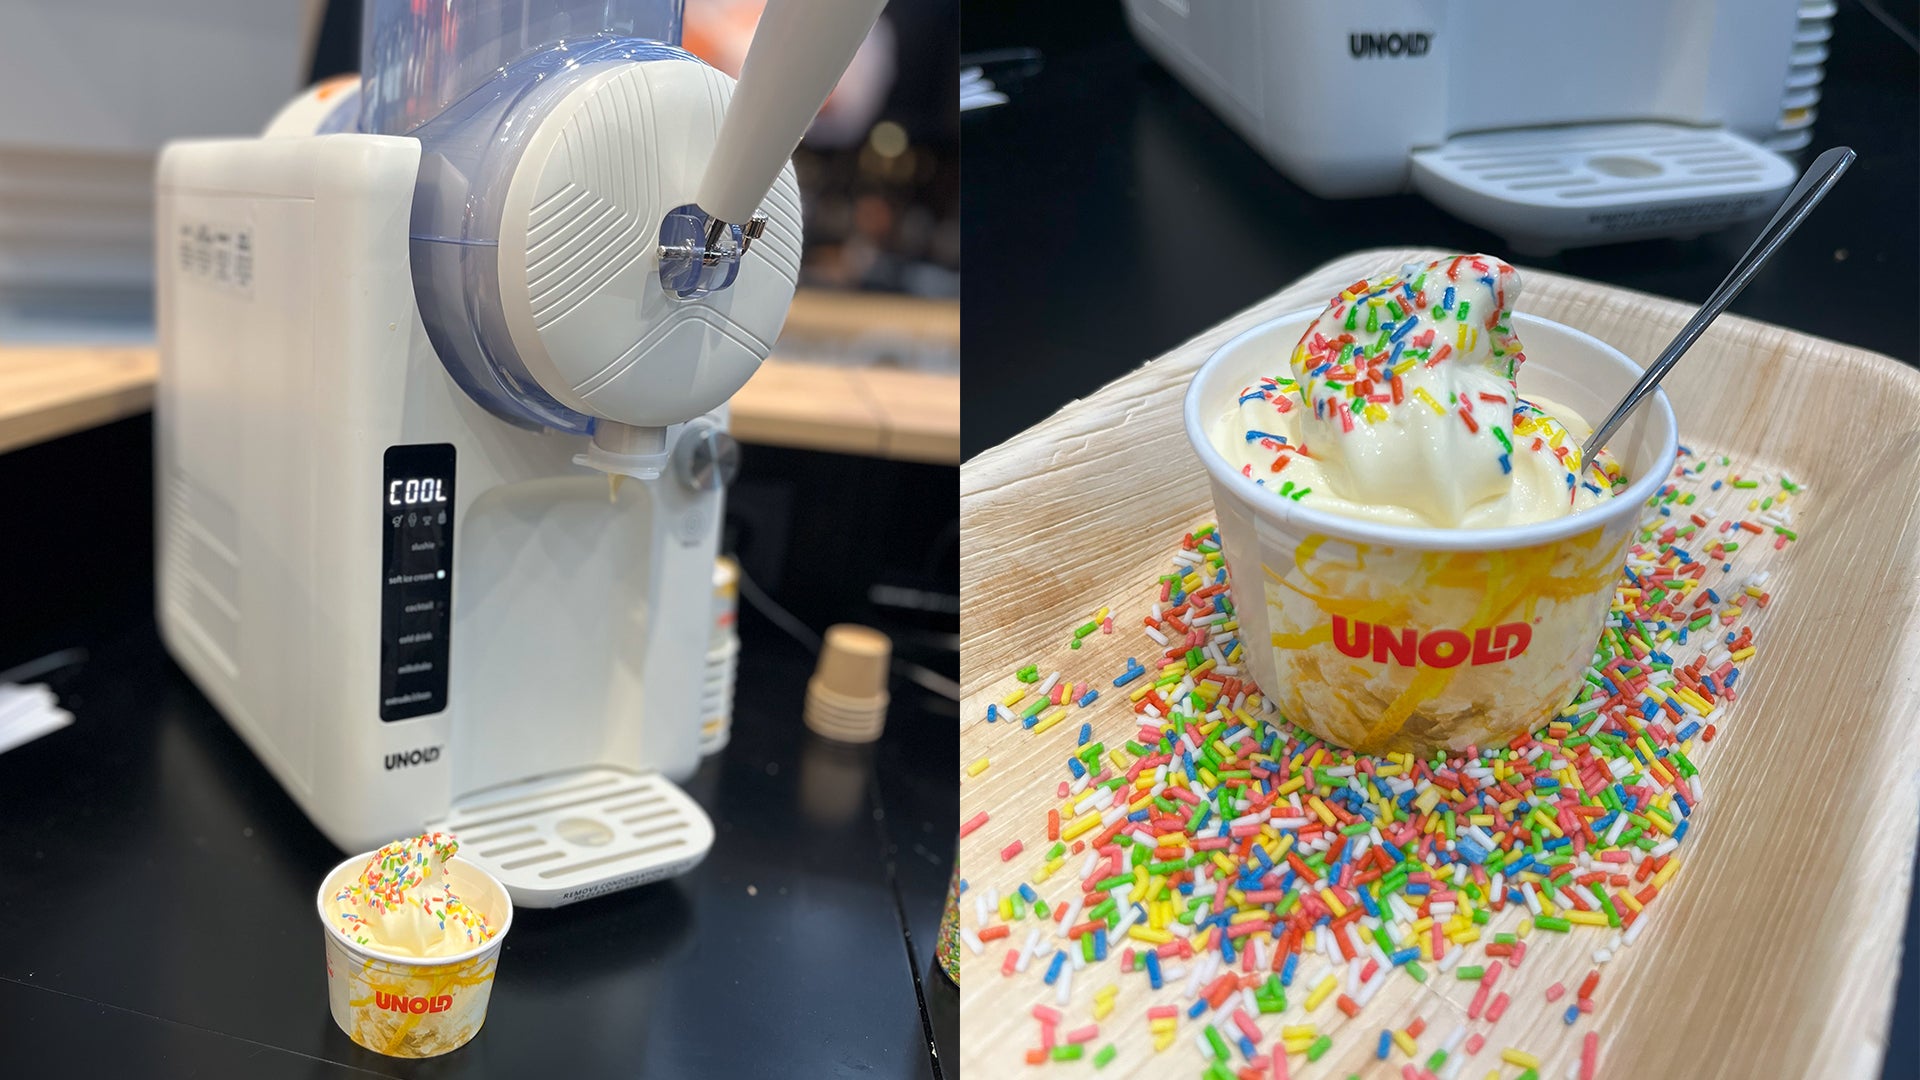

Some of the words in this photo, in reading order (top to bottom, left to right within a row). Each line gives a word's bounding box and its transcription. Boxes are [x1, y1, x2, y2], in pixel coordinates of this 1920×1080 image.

[1349, 32, 1433, 59] UNOLD
[389, 478, 447, 505] COOL
[389, 575, 403, 584] soft
[403, 574, 413, 583] ice
[413, 572, 435, 582] cream
[1332, 614, 1533, 669] UNOLD
[385, 747, 443, 771] UNOLD
[563, 884, 599, 900] REMOVE
[375, 991, 454, 1015] UNOLD
